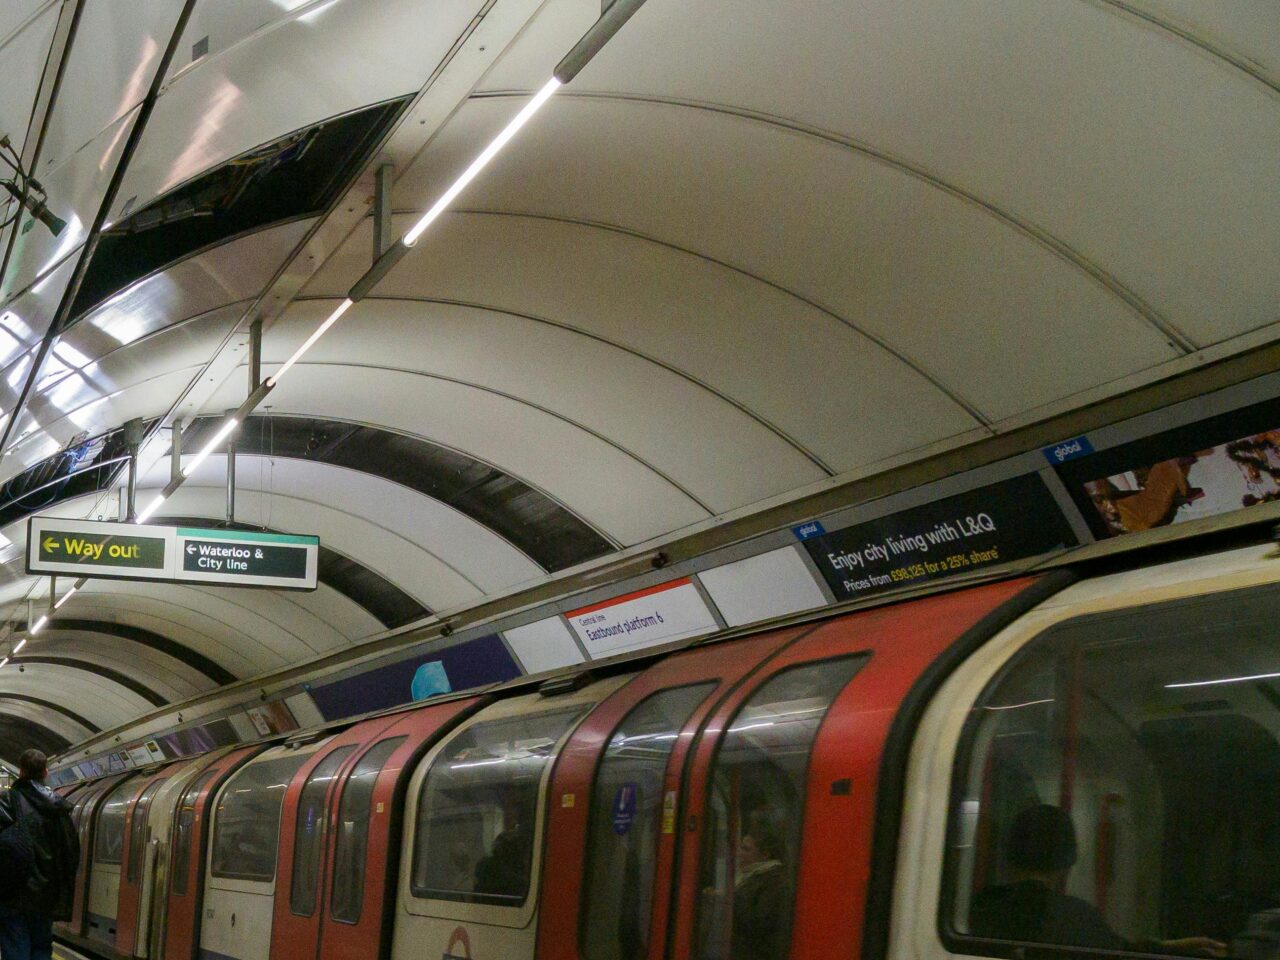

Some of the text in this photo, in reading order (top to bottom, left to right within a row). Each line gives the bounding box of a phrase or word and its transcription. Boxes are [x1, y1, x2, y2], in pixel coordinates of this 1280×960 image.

[1053, 441, 1082, 462] global
[799, 523, 818, 538] global
[827, 512, 997, 570] Enjoy city living with L&Q
[64, 538, 141, 560] Way out
[199, 544, 264, 559] Waterloo &
[198, 558, 248, 570] City line
[843, 578, 871, 592] Prices
[869, 573, 891, 587] from
[924, 559, 940, 574] for
[947, 554, 969, 568] 25%
[578, 615, 599, 627] Central
[586, 611, 664, 642] Eastbound platform 6
